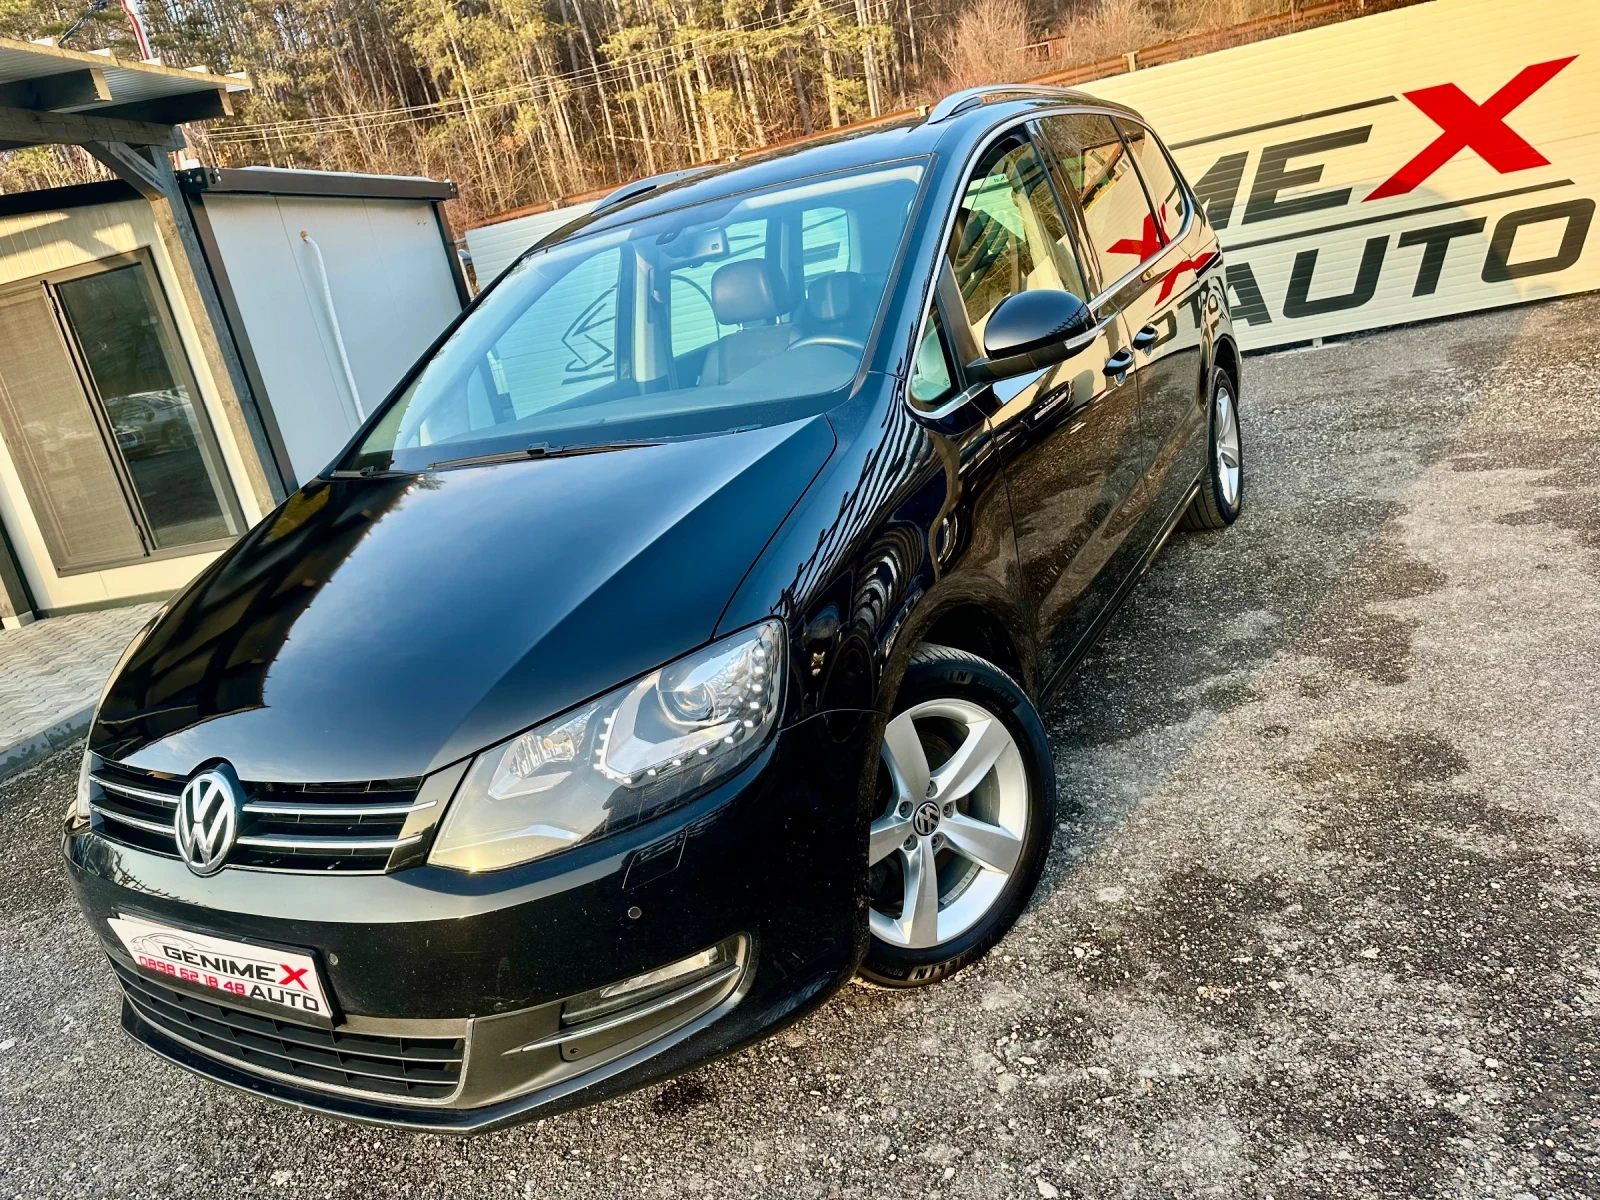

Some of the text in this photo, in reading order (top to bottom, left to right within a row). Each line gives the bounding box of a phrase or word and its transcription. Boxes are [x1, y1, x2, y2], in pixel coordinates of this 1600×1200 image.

[1225, 198, 1597, 327] AUTO
[138, 956, 246, 996] 0898 62 18 48
[163, 945, 310, 991] GENIMEX
[250, 984, 319, 1012] AUTO
